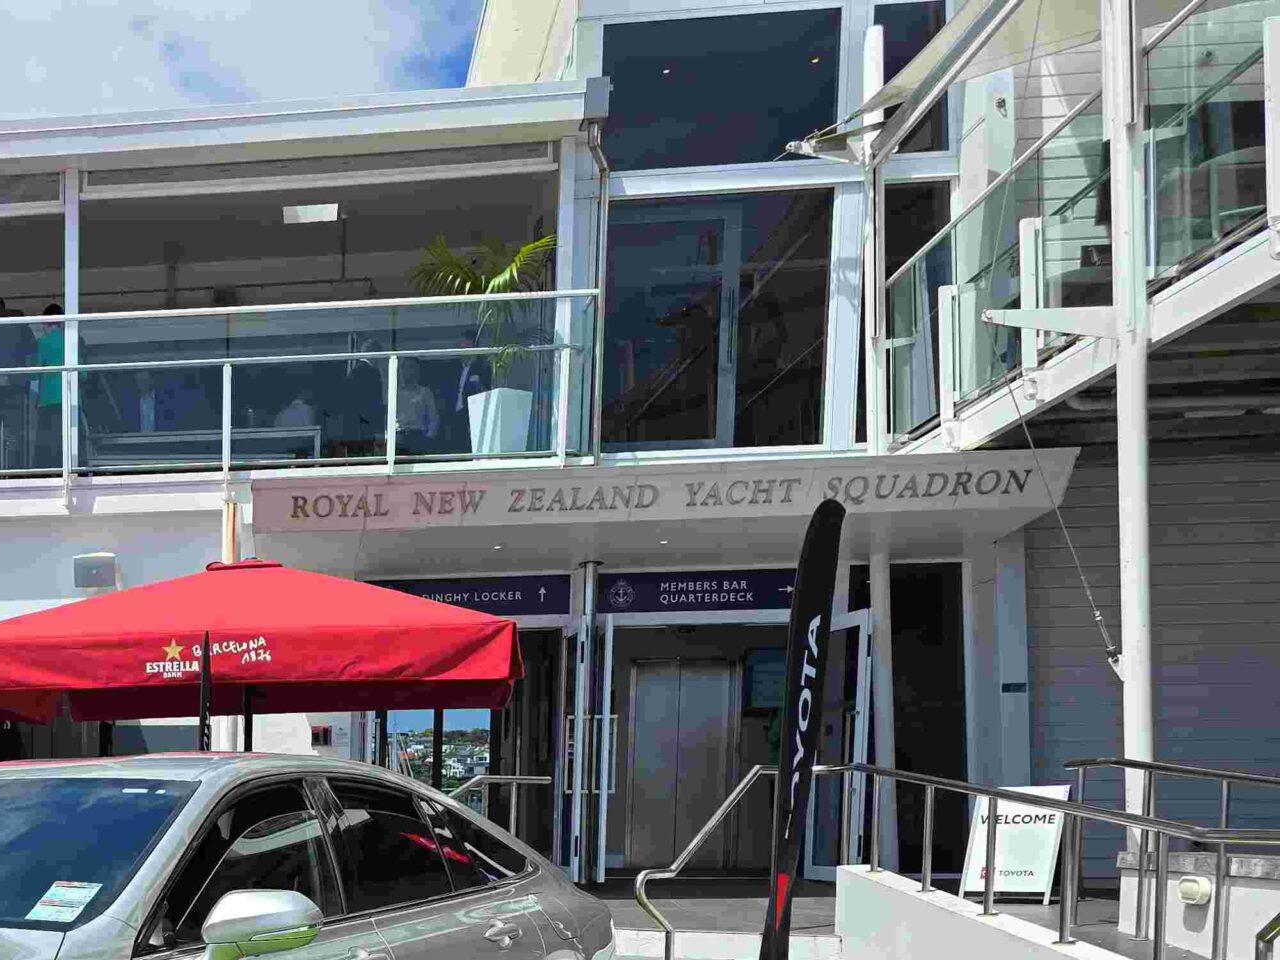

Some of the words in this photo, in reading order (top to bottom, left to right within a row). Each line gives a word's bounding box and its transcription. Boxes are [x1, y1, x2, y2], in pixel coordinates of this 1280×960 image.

[290, 493, 389, 518] ROYAL
[412, 489, 486, 515] NEW
[507, 484, 660, 513] ZEALAND
[685, 478, 802, 507] YACHT
[823, 469, 1033, 505] SQUADRON
[660, 581, 718, 592] MEMBERS
[723, 580, 748, 590] BAR
[474, 592, 522, 601] LOCKER
[660, 592, 754, 605] QUARTERDECK
[192, 636, 266, 657] BRCELONA
[242, 649, 271, 664] 1876
[146, 661, 199, 673] ESTRELLA
